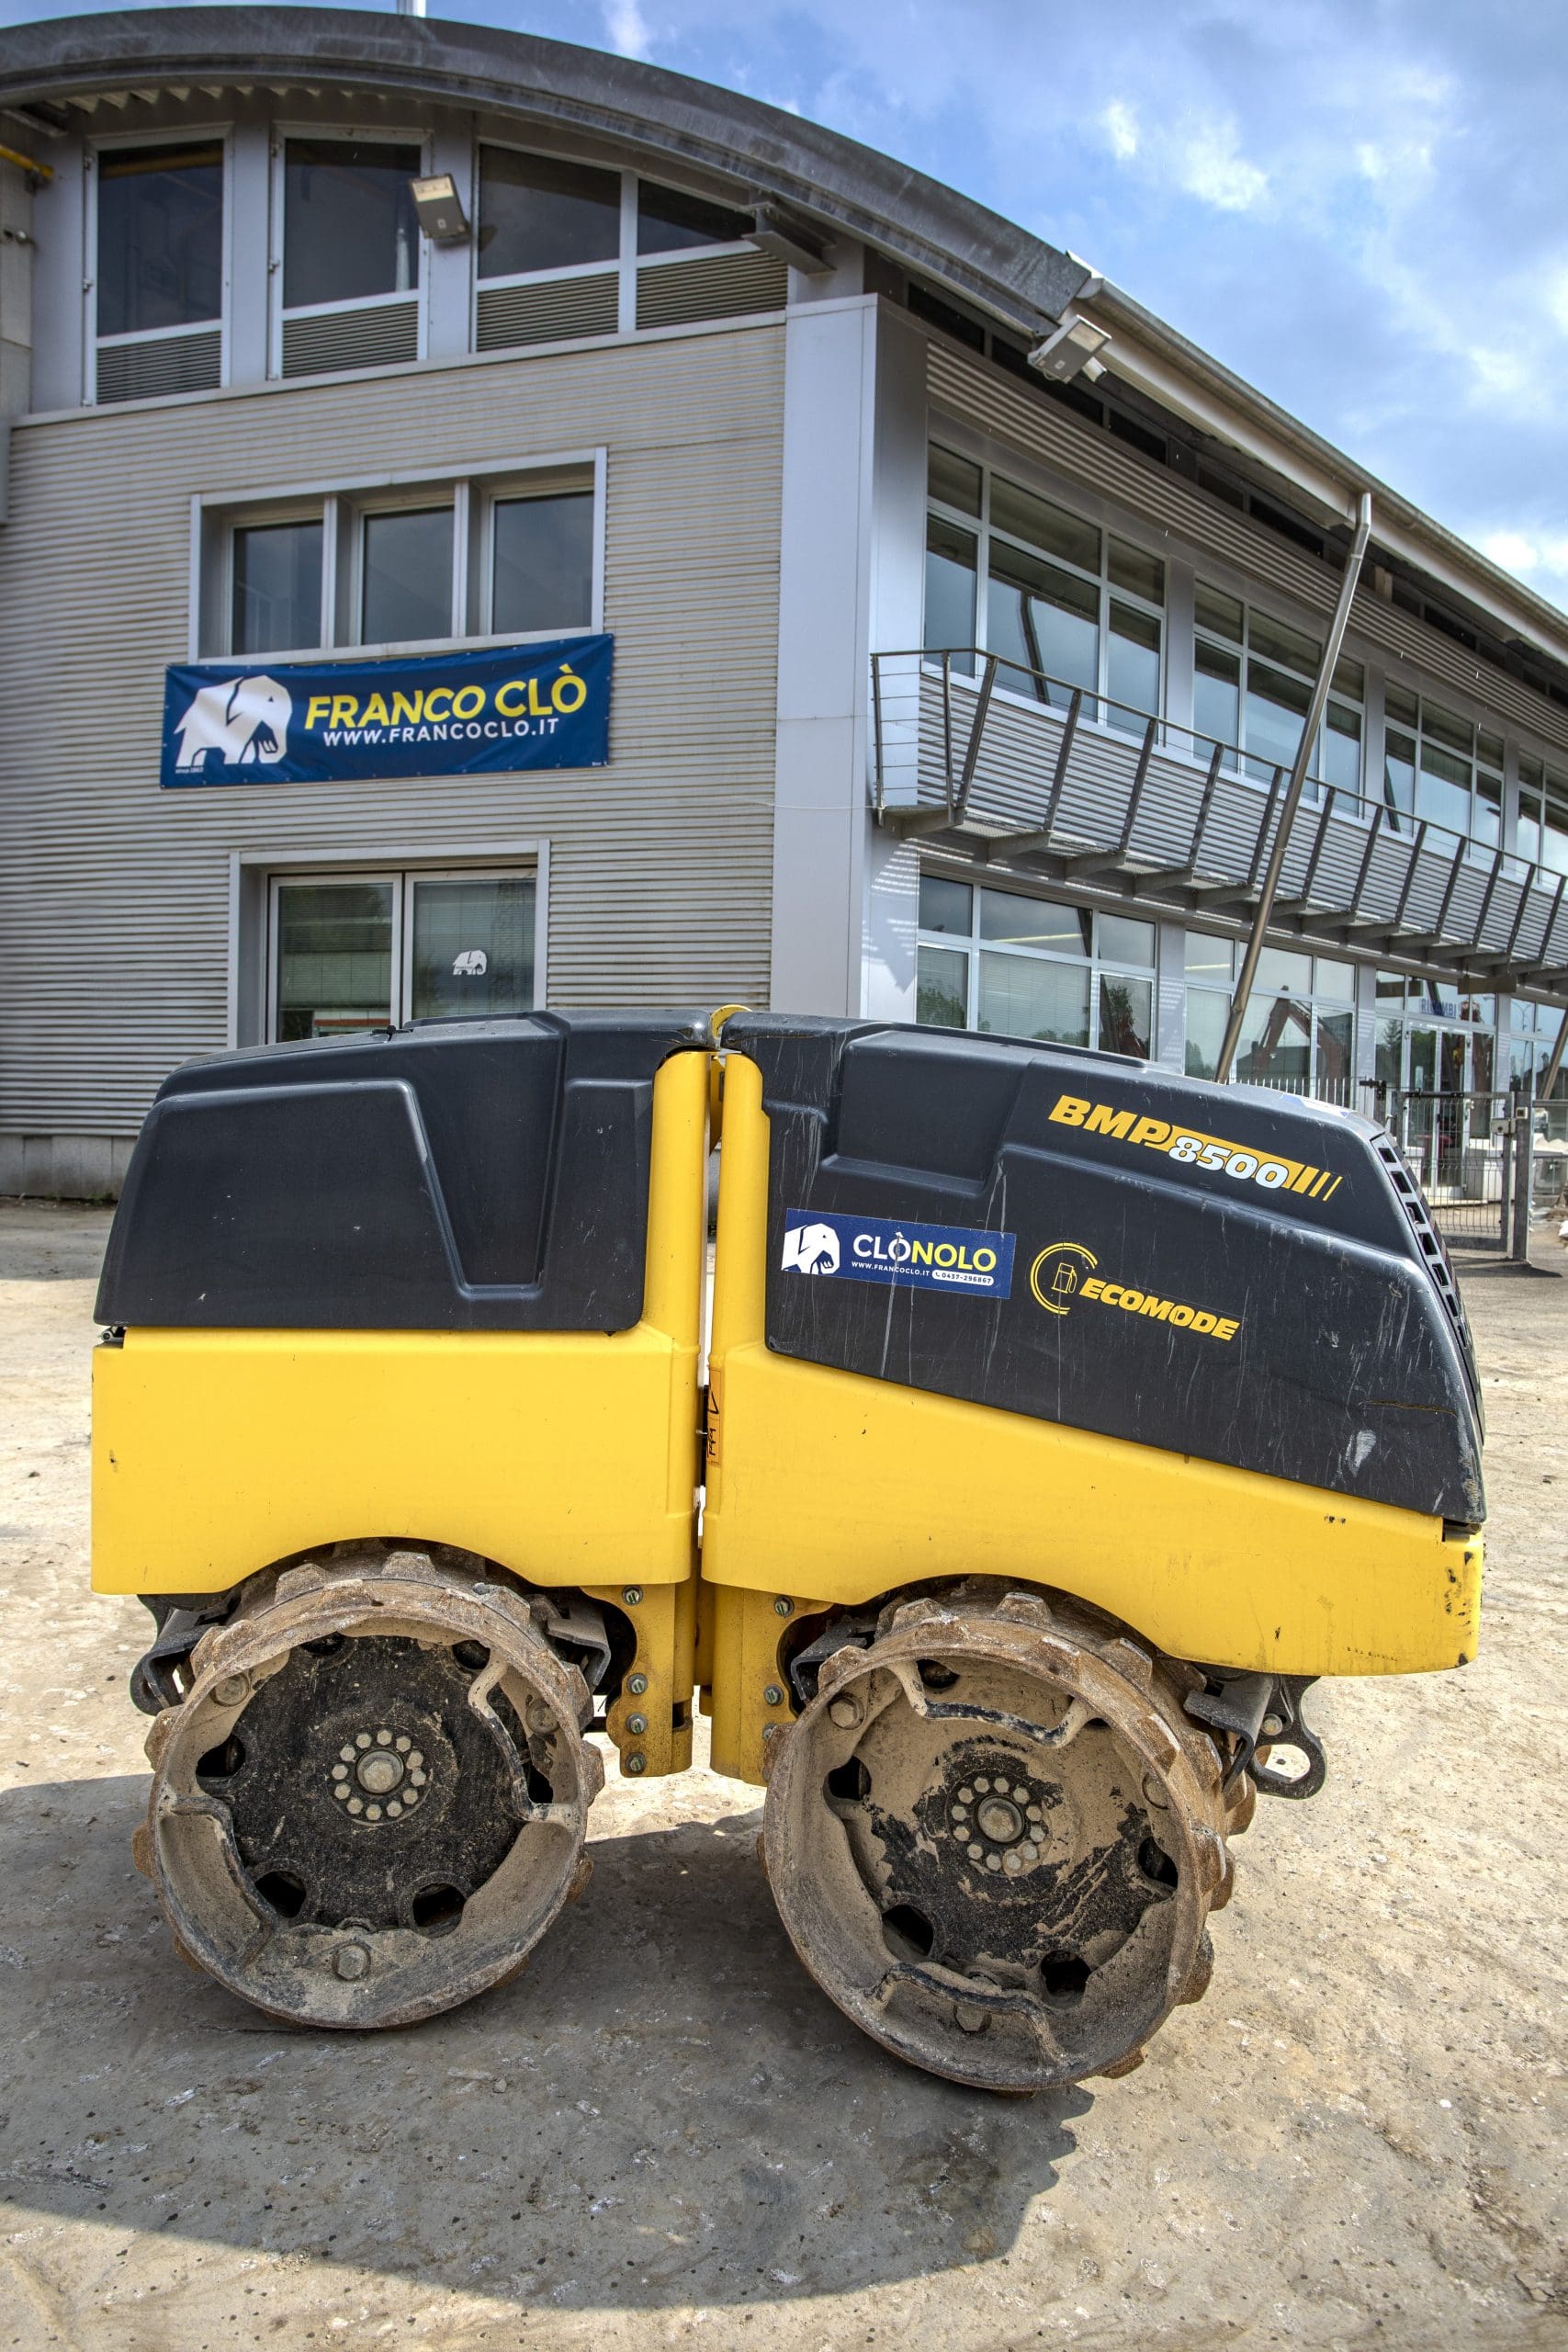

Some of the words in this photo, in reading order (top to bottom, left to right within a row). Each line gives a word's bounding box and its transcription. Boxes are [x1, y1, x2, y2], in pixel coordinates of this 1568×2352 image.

[304, 685, 486, 730] FRANCO
[494, 663, 588, 718] CLÒ
[322, 718, 559, 747] WWW.FRANCOCLO.IT
[851, 1261, 931, 1277] WWW.FRANCOCLO.IT
[1078, 1277, 1241, 1341] ECOMODE
